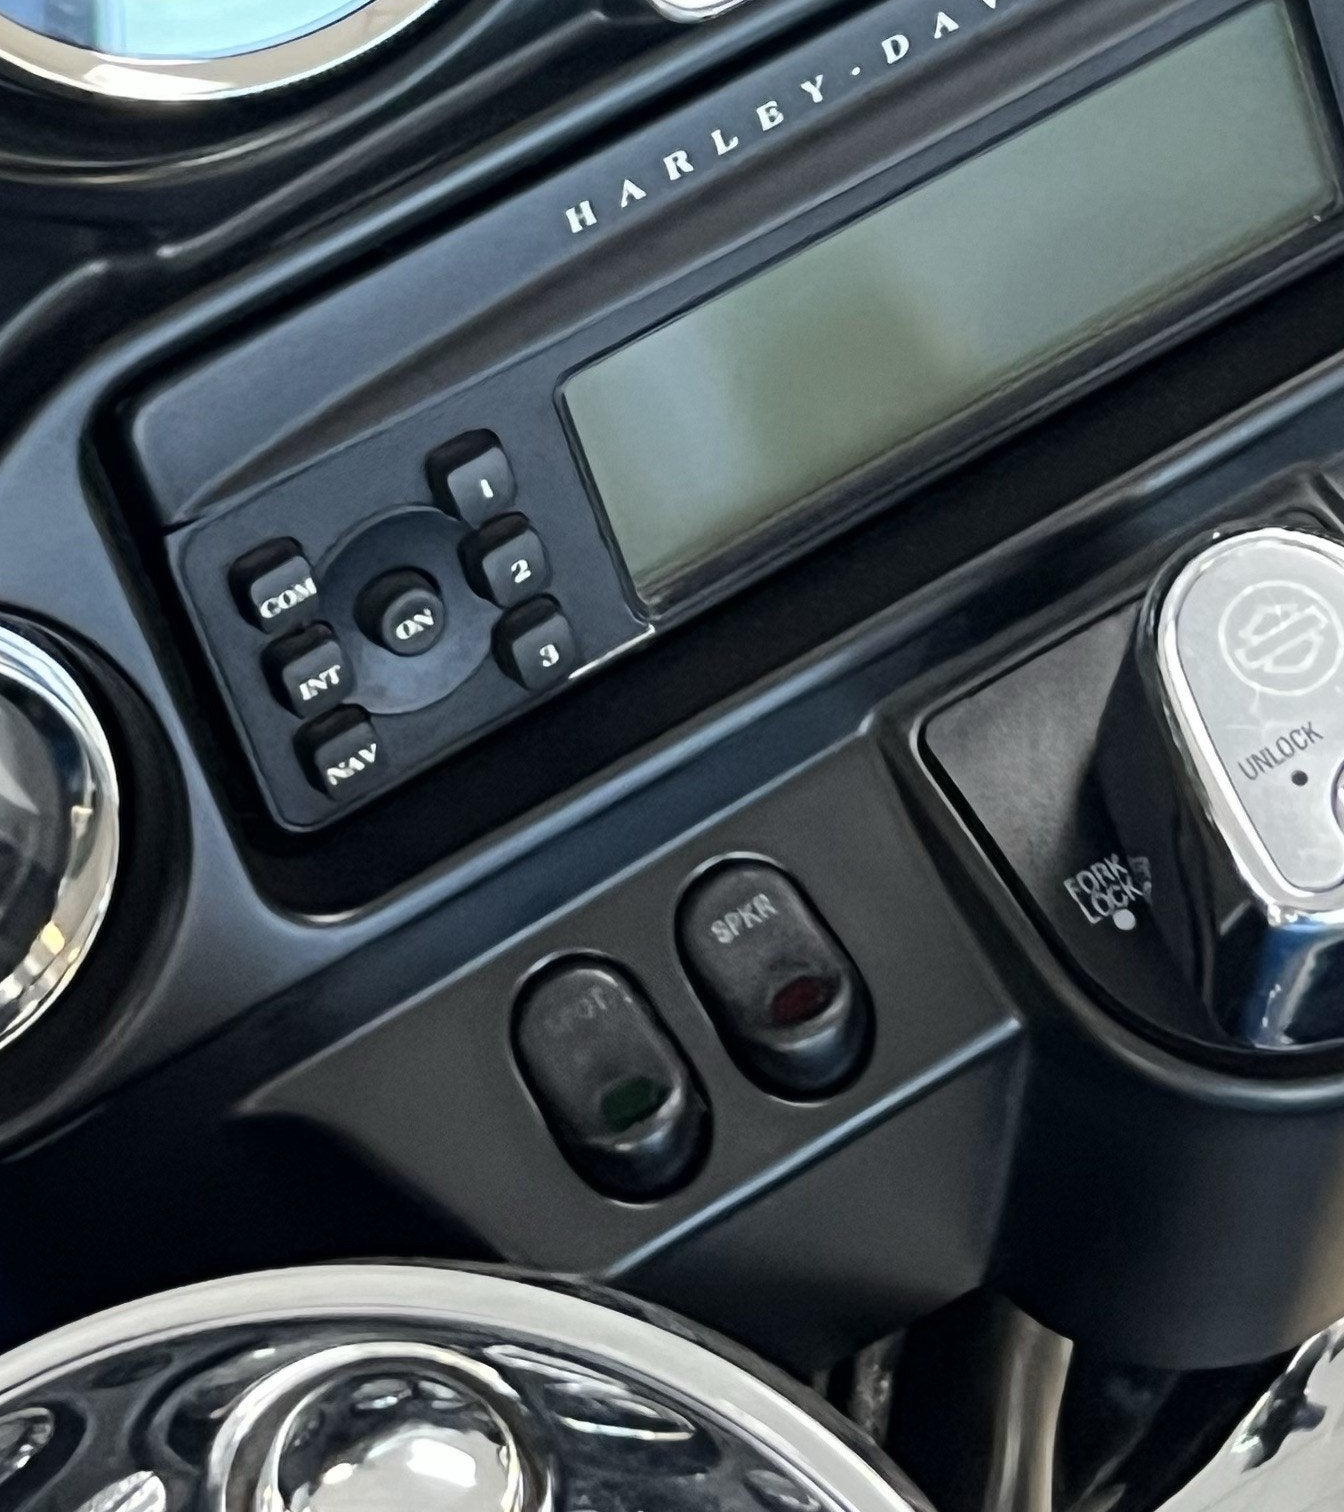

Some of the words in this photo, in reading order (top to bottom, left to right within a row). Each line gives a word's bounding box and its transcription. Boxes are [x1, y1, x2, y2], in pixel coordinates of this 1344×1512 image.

[480, 478, 494, 498] 1
[511, 559, 532, 584] 2
[395, 608, 434, 640] ON
[539, 643, 560, 668] 3
[299, 664, 341, 700] INT
[326, 744, 377, 786] NAV
[1236, 720, 1324, 782] UNLOCK
[1063, 853, 1130, 898] FORK
[710, 893, 779, 944] SPKR
[1076, 876, 1144, 924] LOCK
